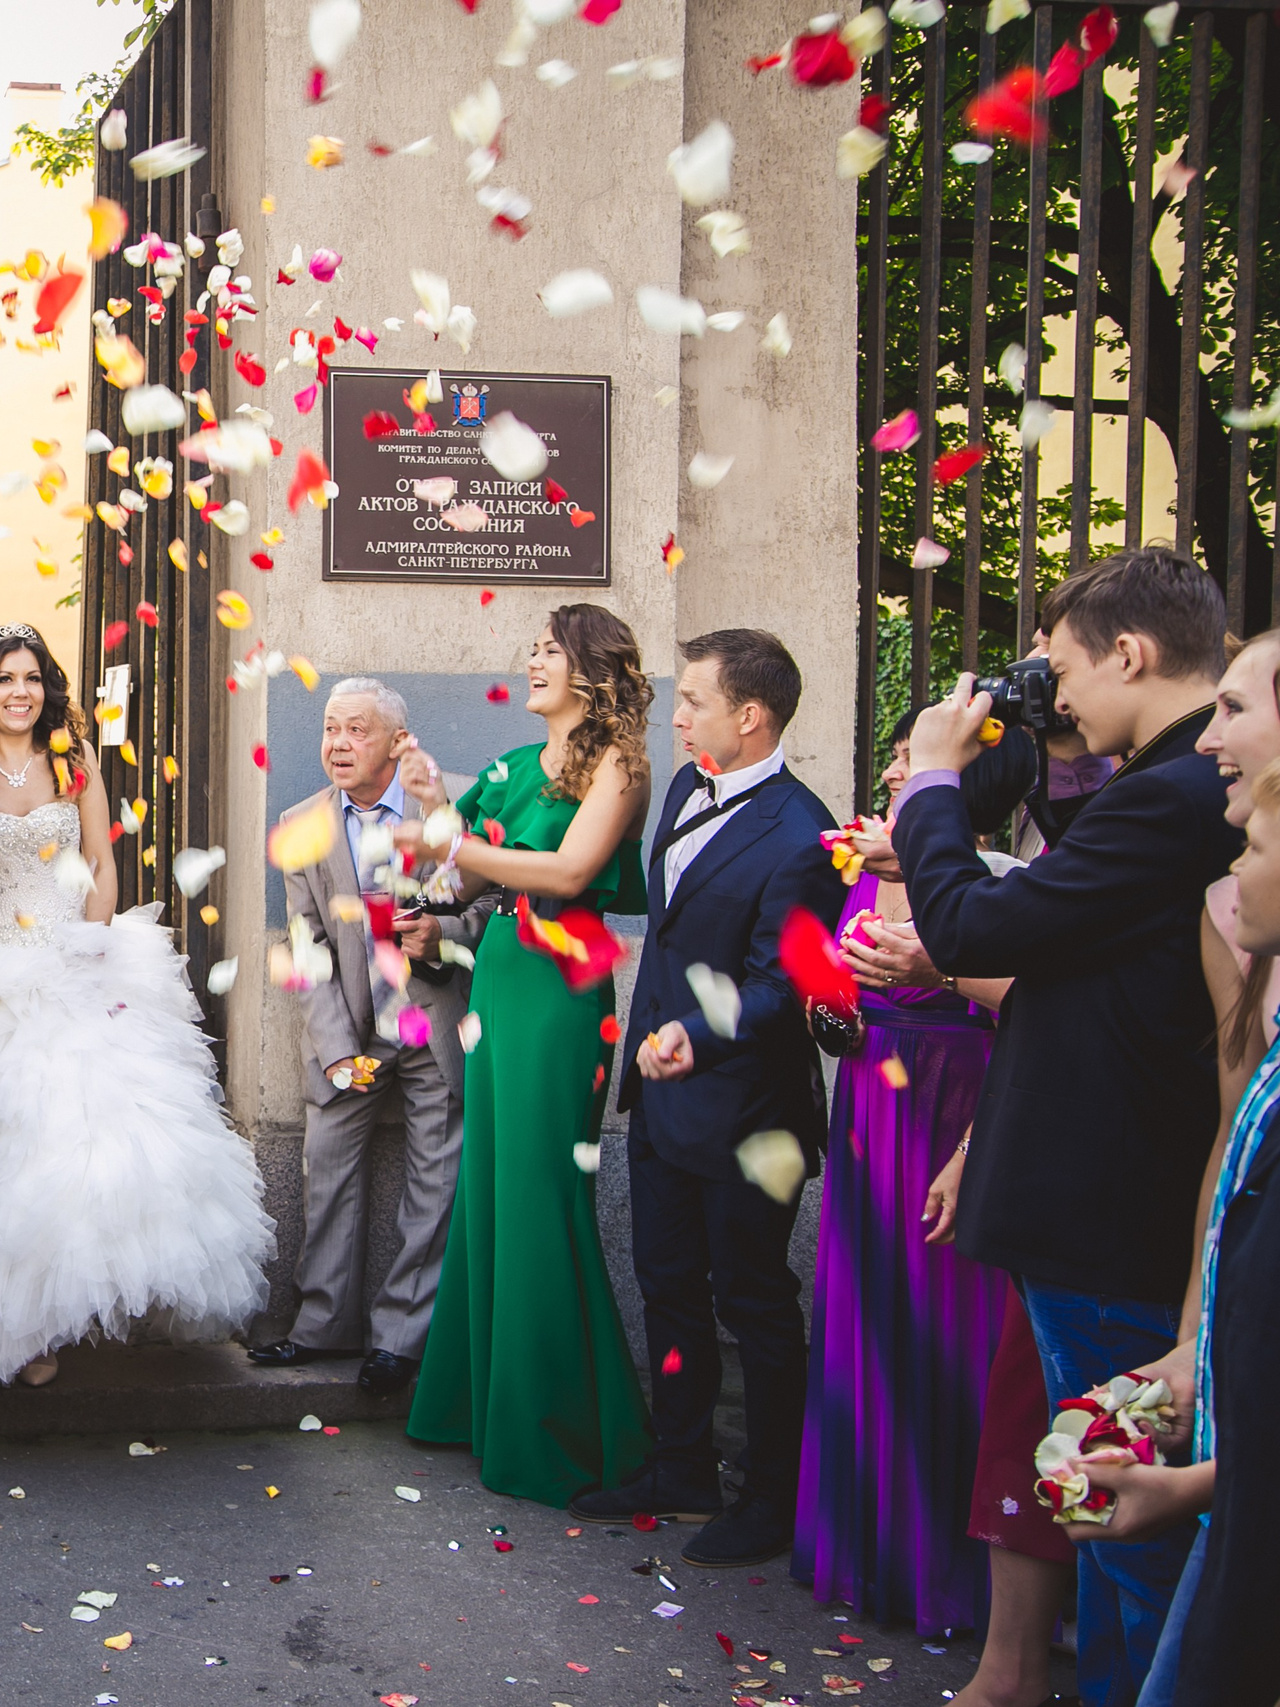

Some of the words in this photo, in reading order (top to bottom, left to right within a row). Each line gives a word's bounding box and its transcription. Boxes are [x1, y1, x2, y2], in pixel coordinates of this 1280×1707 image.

[378, 444, 423, 453] КОМИТЕТ
[427, 445, 441, 454] ПО
[445, 446, 481, 455] ДЕЛАМ
[399, 455, 478, 465] ГРАЖДАНСКОГО
[469, 480, 542, 496] ЗАПИСИ
[357, 496, 419, 512] АКТОВ
[365, 541, 510, 556] АДМИРАЛТЕЙСКОГО
[515, 543, 572, 557] РАЙОНА
[397, 555, 539, 570] САНКТ-ПЕТЕРБУРГА
